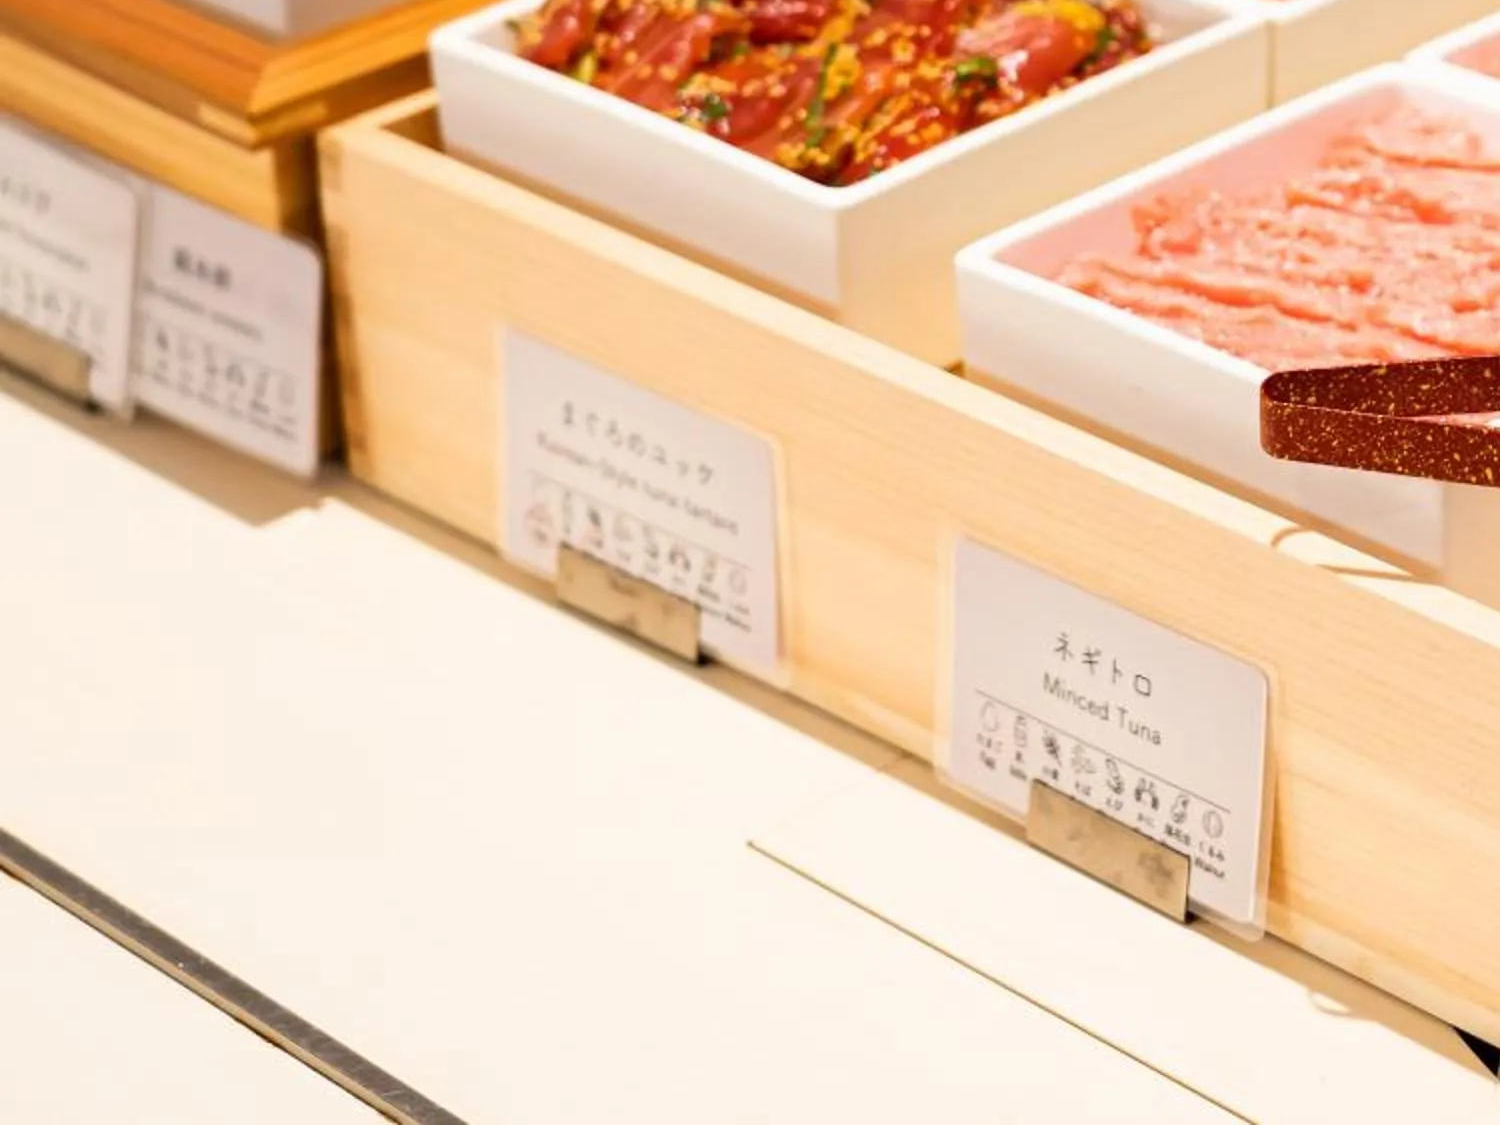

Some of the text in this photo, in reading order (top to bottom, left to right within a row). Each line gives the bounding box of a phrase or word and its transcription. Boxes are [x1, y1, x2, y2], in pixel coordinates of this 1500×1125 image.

[1053, 632, 1153, 697] ネギトロ
[1042, 671, 1162, 746] Minced Tuna
